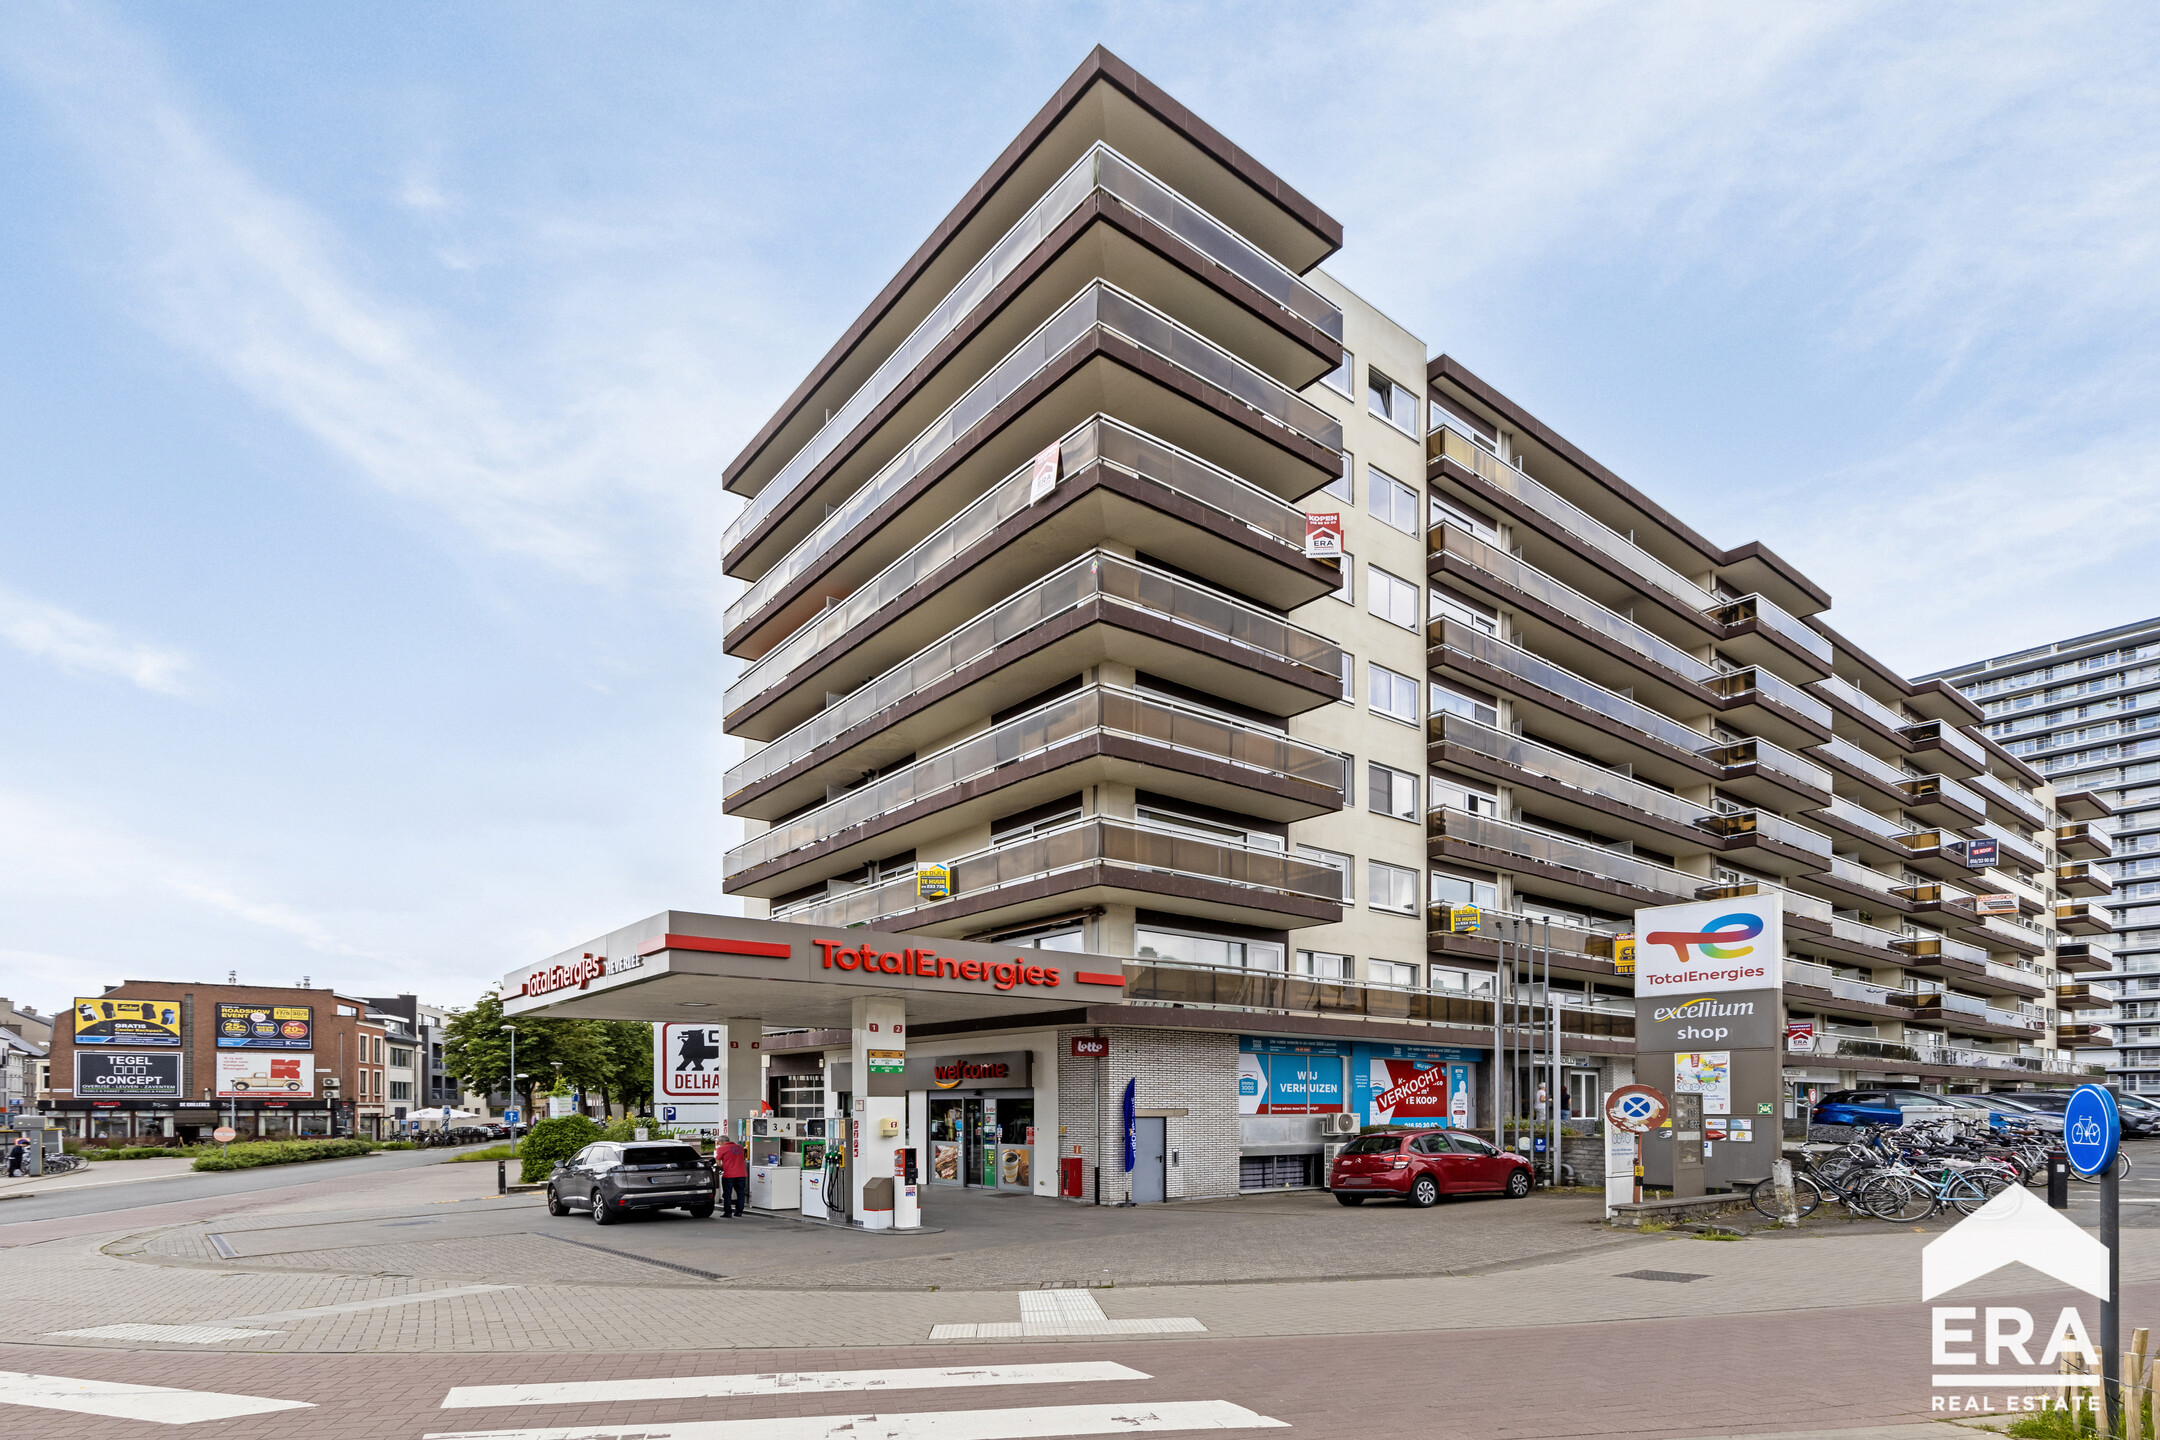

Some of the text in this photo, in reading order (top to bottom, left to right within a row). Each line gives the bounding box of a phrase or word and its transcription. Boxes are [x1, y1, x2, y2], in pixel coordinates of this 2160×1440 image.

[813, 939, 1061, 990] TotalEnergies
[527, 953, 644, 997] TotalEnergies HEVERLEE
[1646, 966, 1764, 985] TotalEnergies
[1654, 1000, 1754, 1018] excellium
[1677, 1026, 1728, 1041] shop
[1078, 1041, 1102, 1052] Lotto
[107, 1056, 152, 1065] TEGEL
[934, 1060, 1008, 1079] wel'come
[1297, 1071, 1318, 1080] WIJ
[96, 1076, 162, 1084] CONCEPT
[675, 1074, 719, 1088] DELHA
[1379, 1067, 1439, 1108] VERKOCHT
[1280, 1083, 1337, 1093] VERHUIZEN
